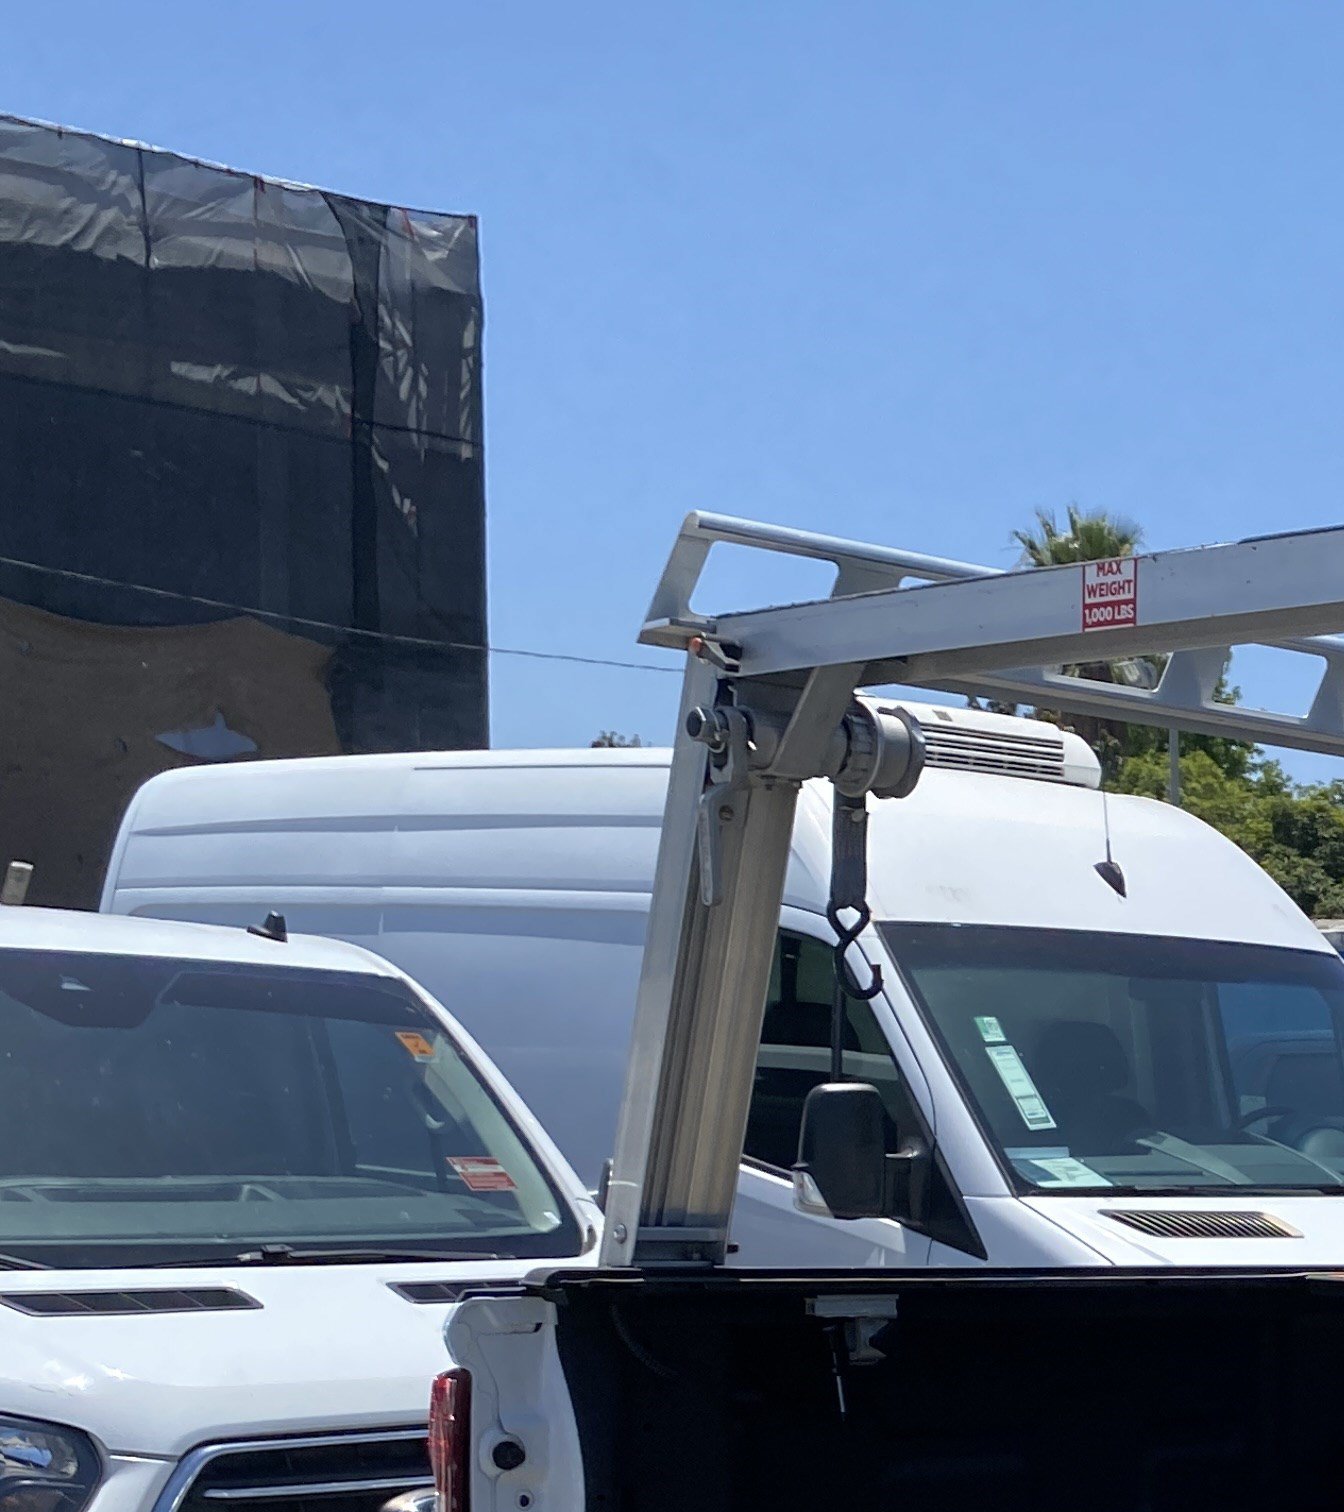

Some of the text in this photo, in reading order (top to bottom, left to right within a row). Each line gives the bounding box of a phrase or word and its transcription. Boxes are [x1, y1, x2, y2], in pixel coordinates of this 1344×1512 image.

[1096, 560, 1122, 577] MAX
[1086, 580, 1133, 598] WEIGHT
[1114, 604, 1134, 619] LBS
